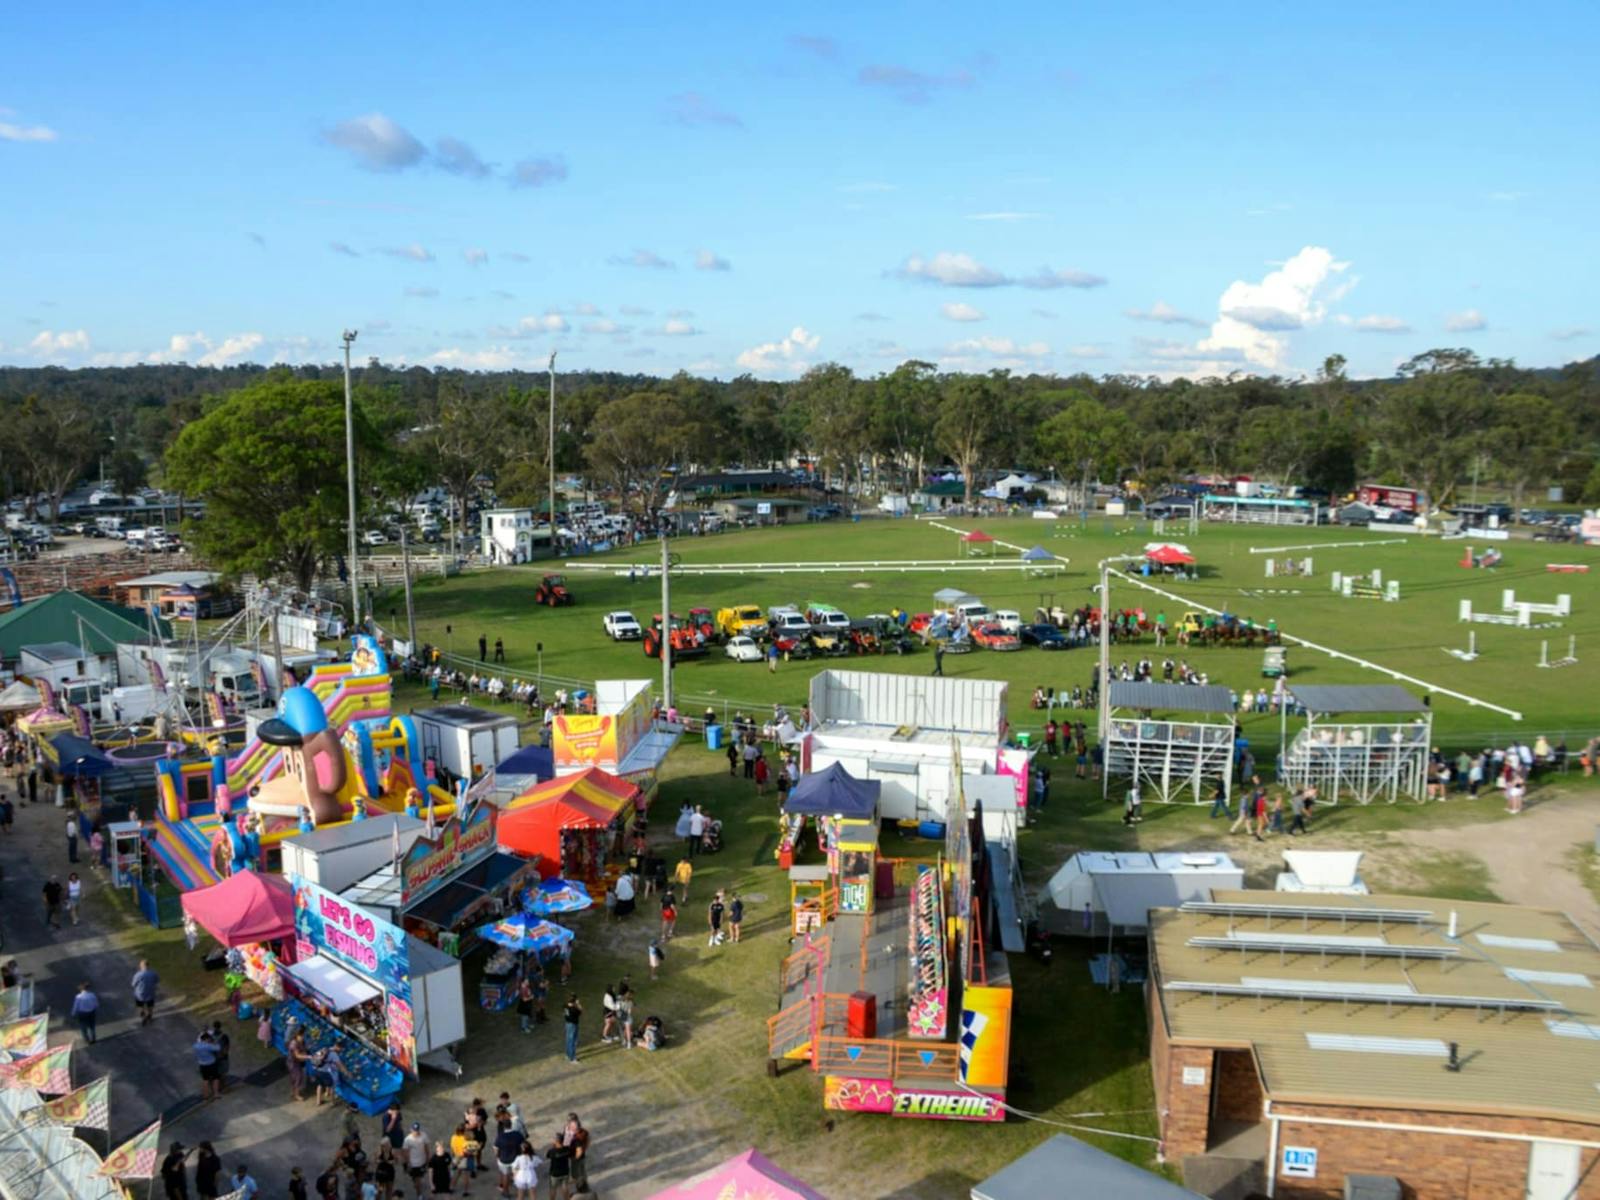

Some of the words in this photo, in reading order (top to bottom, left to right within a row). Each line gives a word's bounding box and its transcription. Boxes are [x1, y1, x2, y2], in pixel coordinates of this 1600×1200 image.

[319, 894, 351, 930] LET'S
[353, 913, 375, 943] GO
[324, 923, 378, 972] FISHING
[895, 1093, 992, 1117] EXTREME
